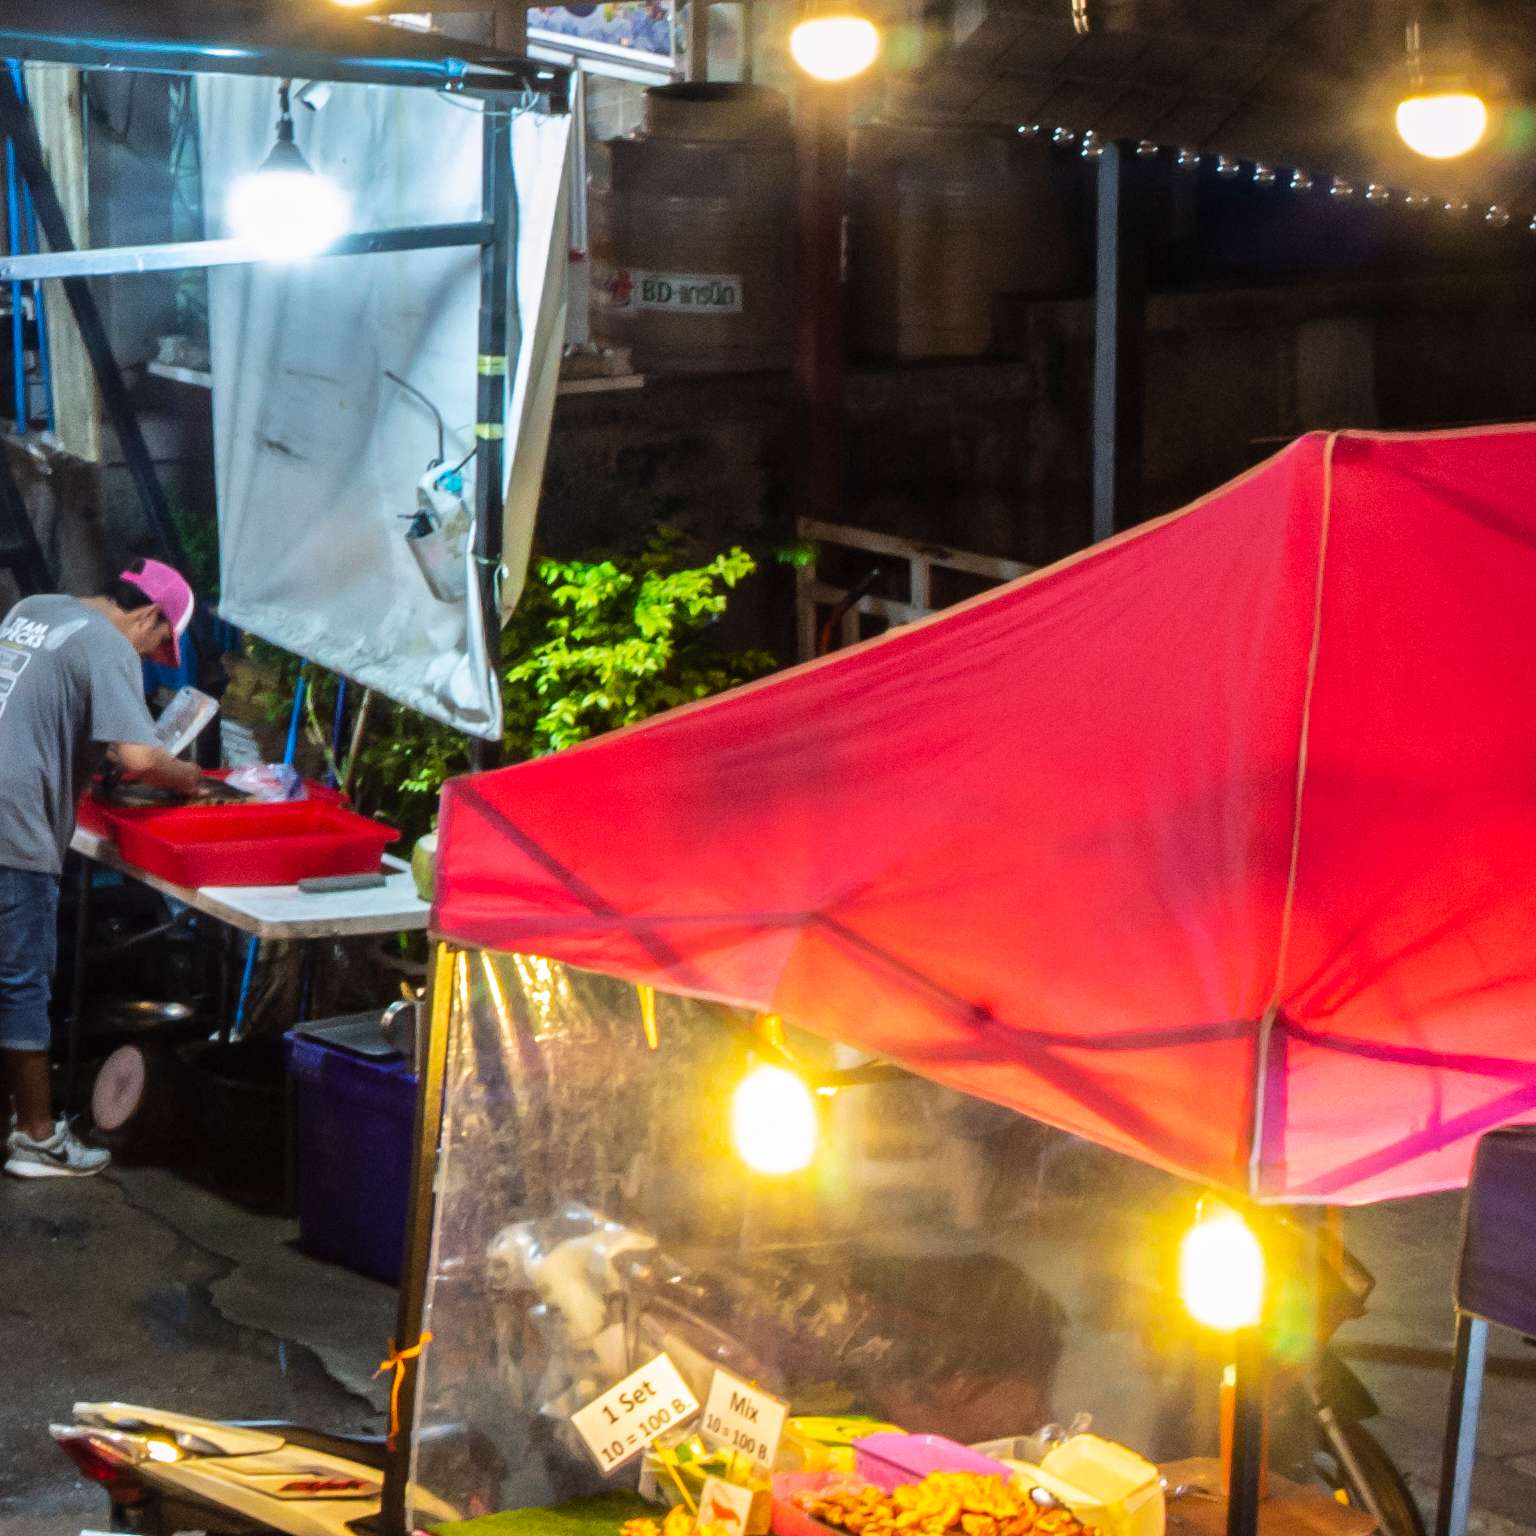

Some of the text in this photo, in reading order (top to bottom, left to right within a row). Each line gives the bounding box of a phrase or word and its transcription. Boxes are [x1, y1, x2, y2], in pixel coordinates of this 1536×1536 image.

[602, 1379, 657, 1425] 1 Set
[729, 1391, 760, 1424] Mix
[601, 1441, 625, 1463] 10
[638, 1408, 671, 1438] 100
[706, 1413, 721, 1434] 10
[732, 1429, 756, 1454] 100
